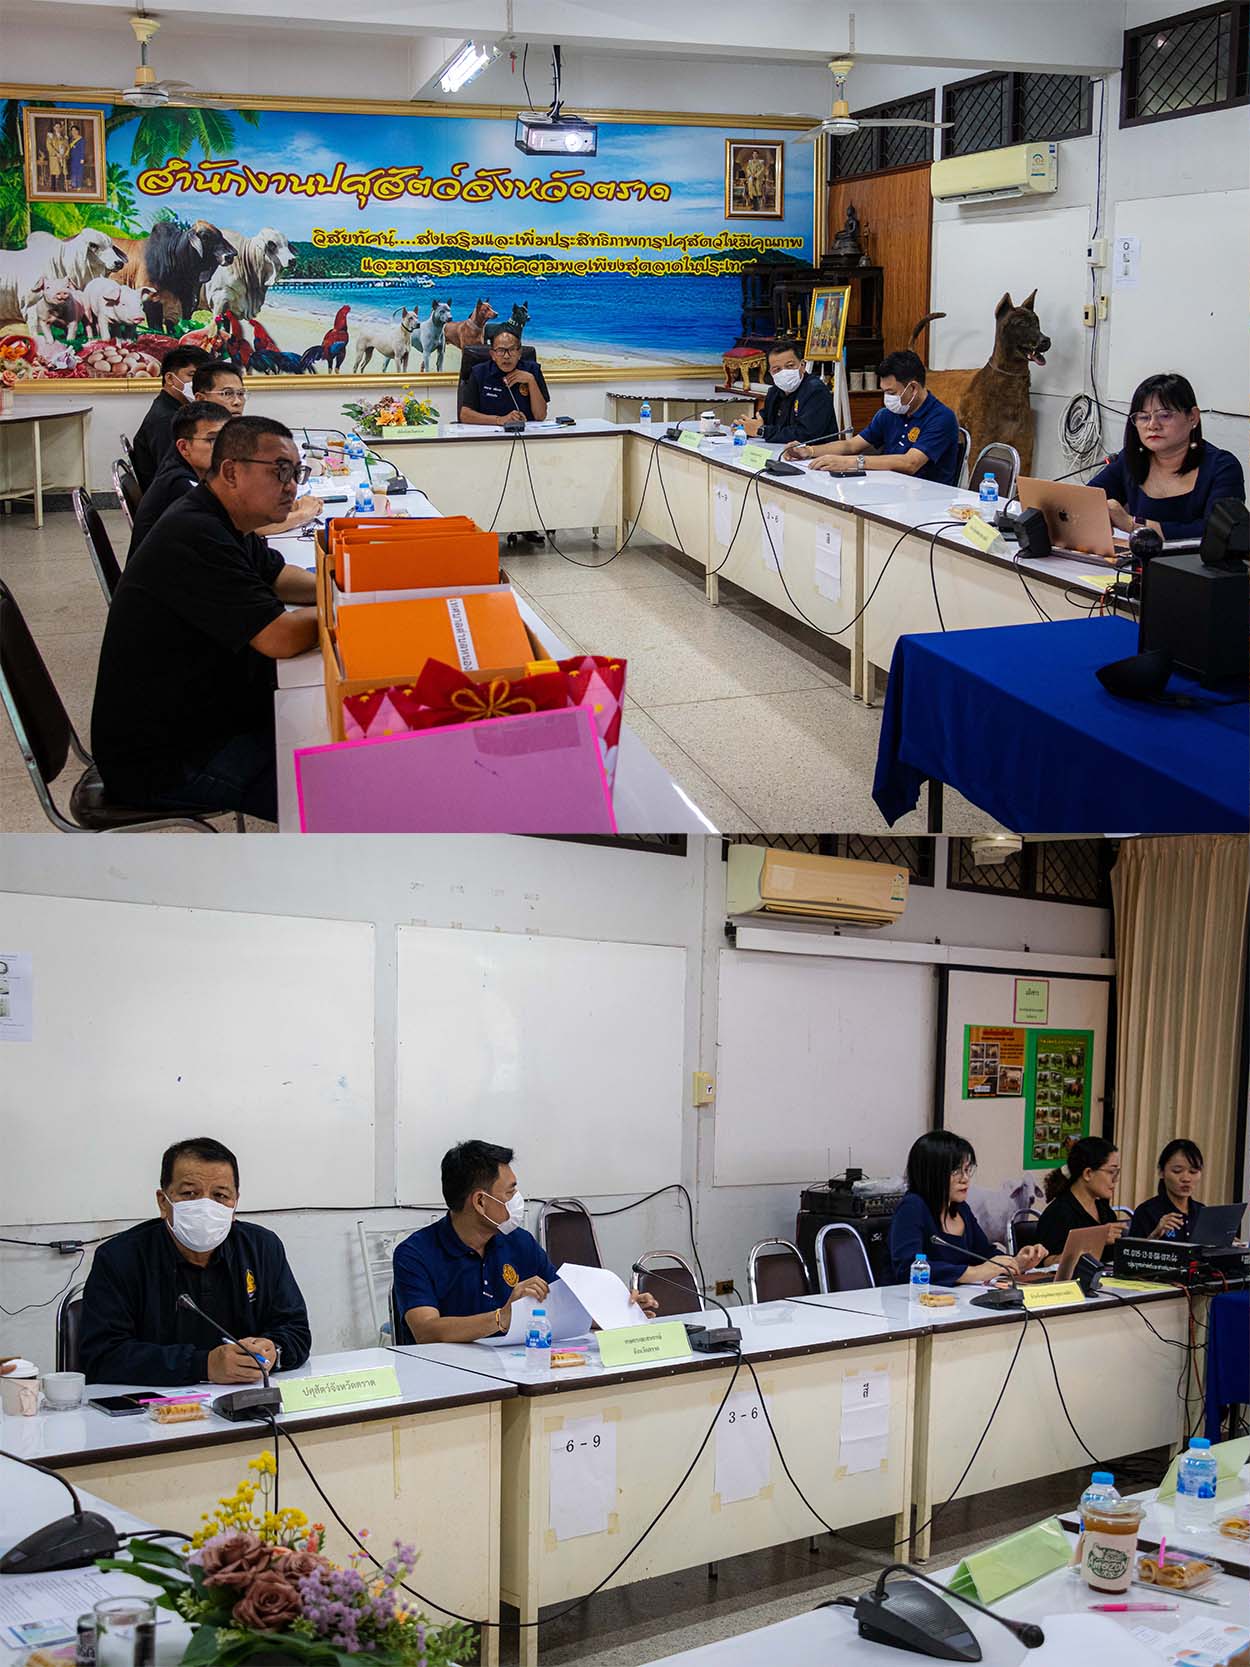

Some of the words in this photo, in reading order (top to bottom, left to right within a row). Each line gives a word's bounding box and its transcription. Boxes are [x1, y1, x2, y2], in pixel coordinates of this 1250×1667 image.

[137, 157, 671, 210] สำนักงานปศุสัตว์จังหวัดตราด
[728, 1411, 736, 1424] 3
[751, 1407, 759, 1420] 6
[566, 1439, 574, 1453] 6
[593, 1434, 601, 1448] 9
